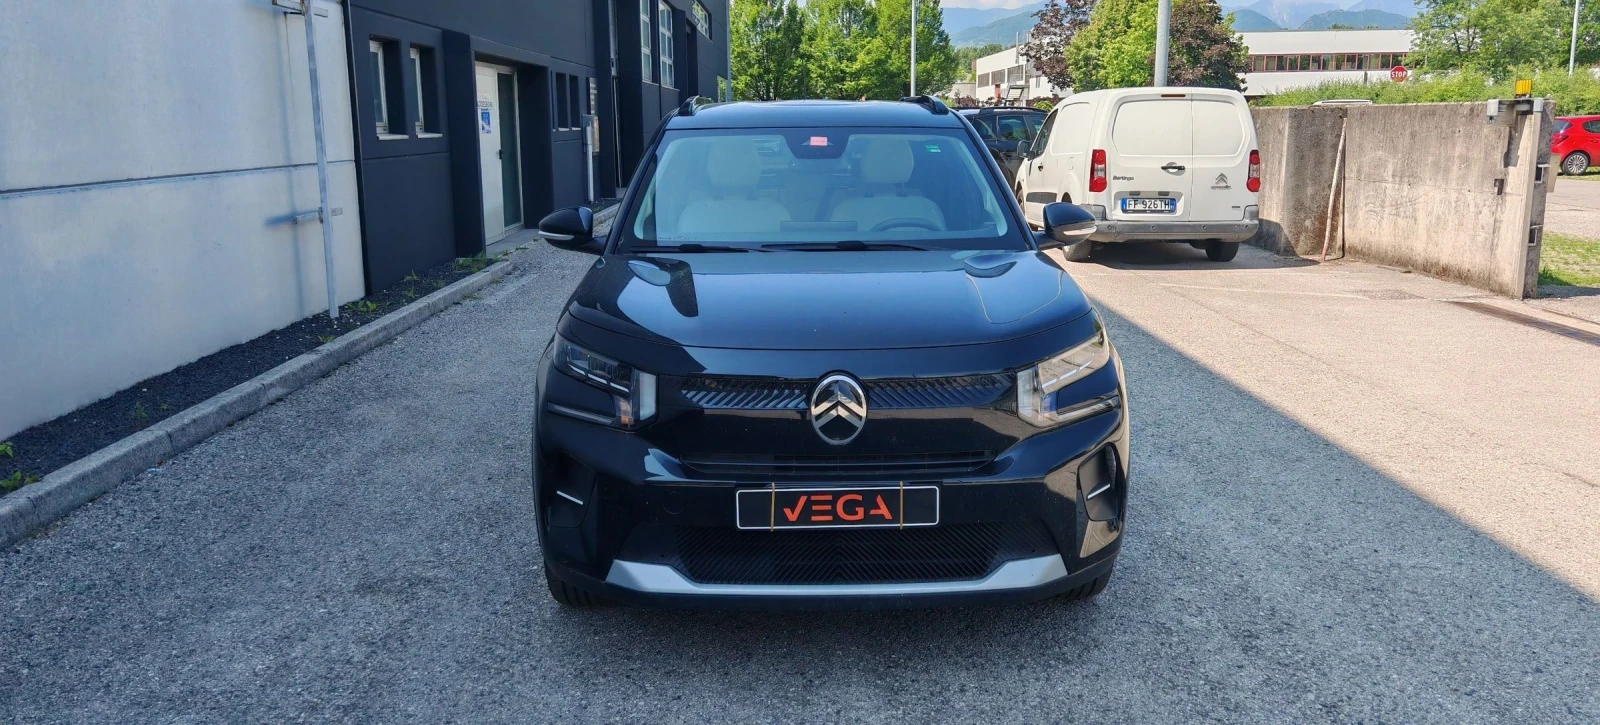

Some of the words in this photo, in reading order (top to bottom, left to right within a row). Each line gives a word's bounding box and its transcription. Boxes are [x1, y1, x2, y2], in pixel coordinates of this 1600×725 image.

[1128, 199, 1139, 209] FF
[1141, 199, 1170, 209] 926TH
[783, 493, 893, 522] VEGA
